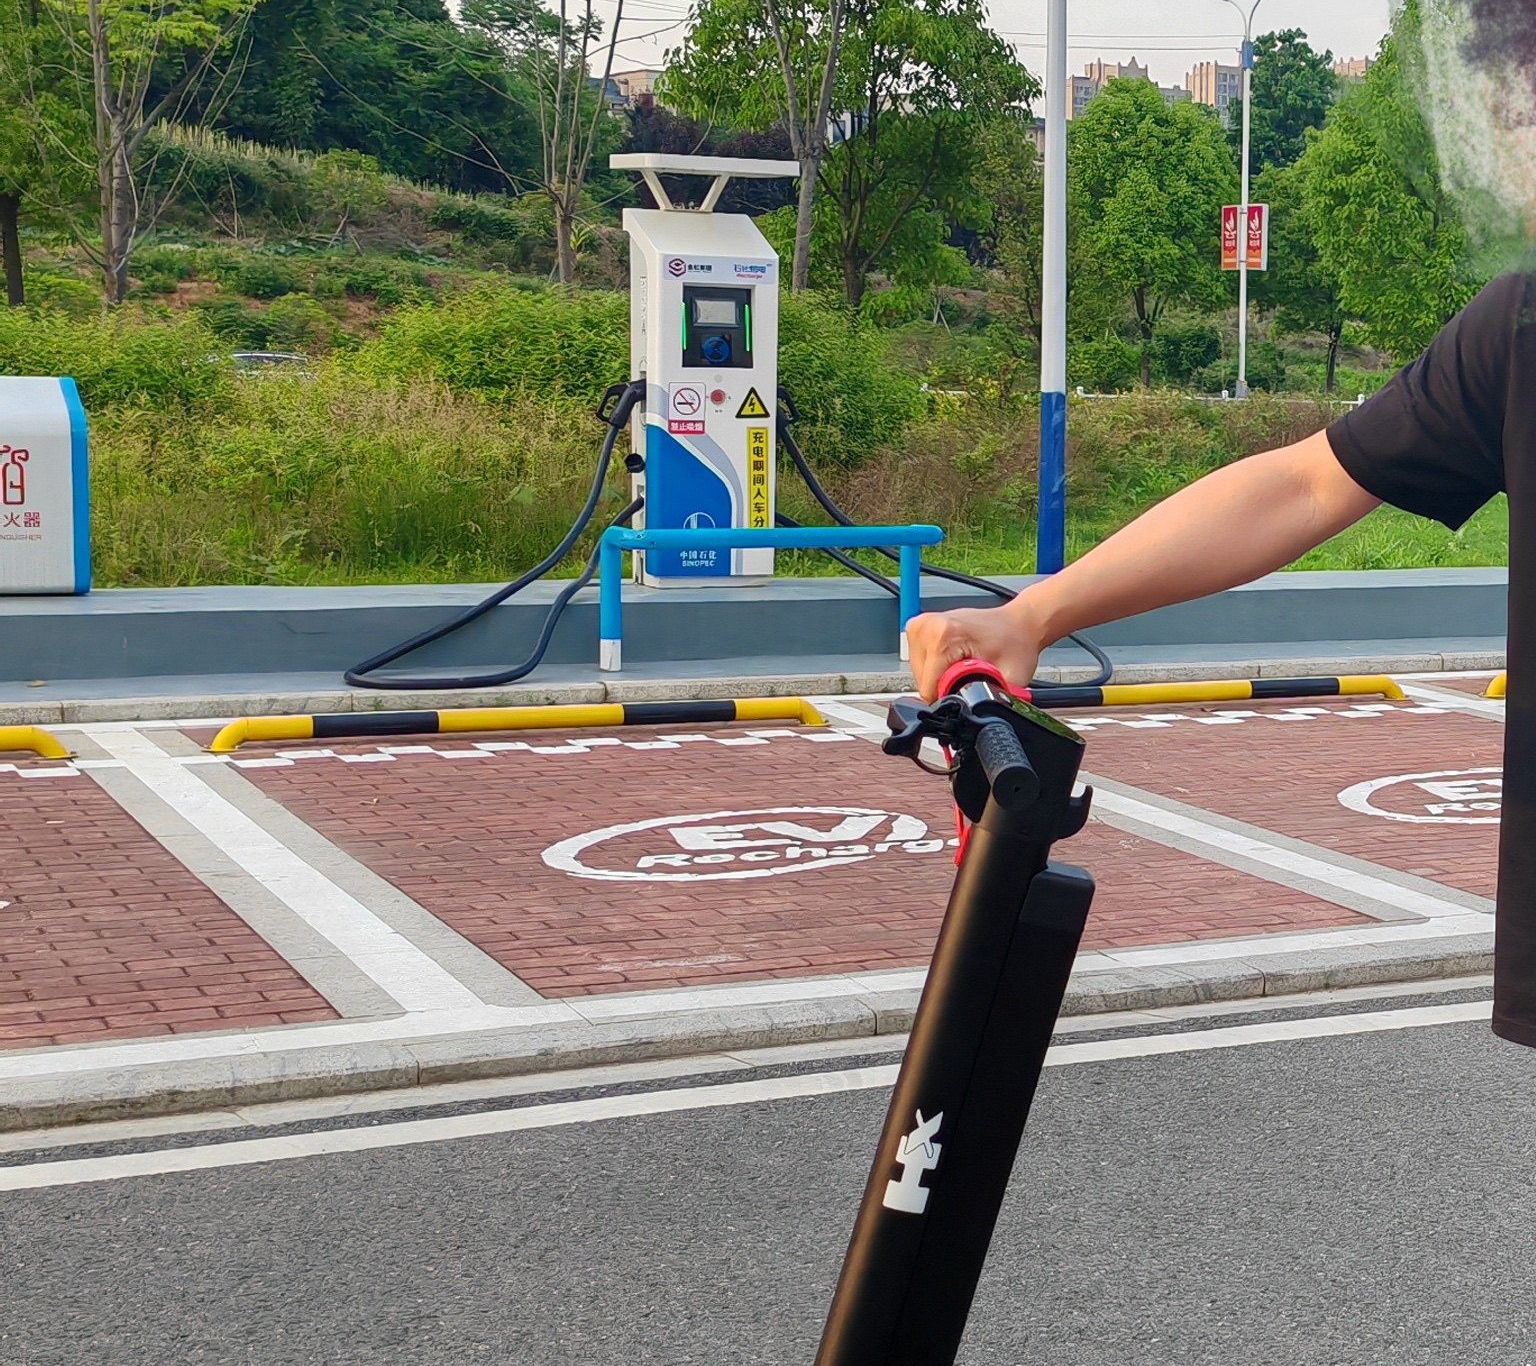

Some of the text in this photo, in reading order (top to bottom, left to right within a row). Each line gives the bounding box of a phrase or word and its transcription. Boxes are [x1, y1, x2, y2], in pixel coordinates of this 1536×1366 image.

[0, 511, 41, 528] 火器
[679, 550, 717, 560] 中国石化
[668, 815, 889, 850] EV
[637, 835, 960, 869] Recharg
